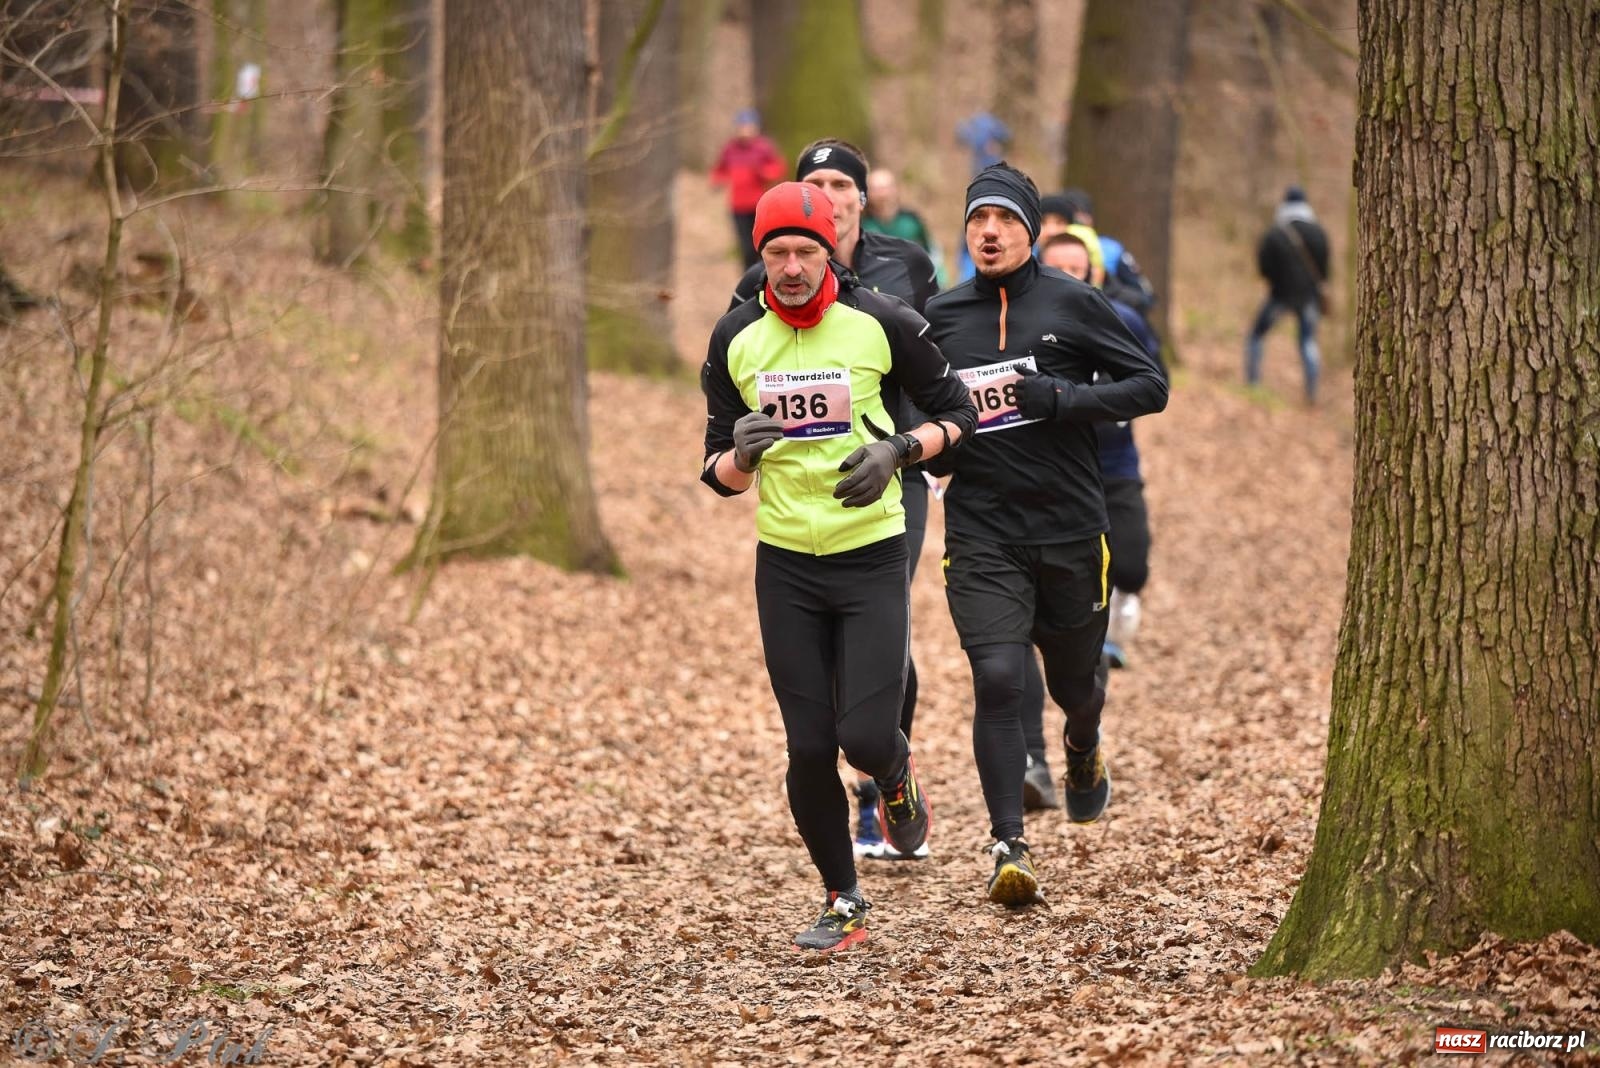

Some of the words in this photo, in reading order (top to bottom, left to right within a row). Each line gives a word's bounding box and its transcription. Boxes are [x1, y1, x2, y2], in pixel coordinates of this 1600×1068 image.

[765, 374, 784, 383] BIEG
[785, 371, 842, 382] Twardziela
[778, 393, 829, 420] 136
[972, 383, 1017, 413] 168
